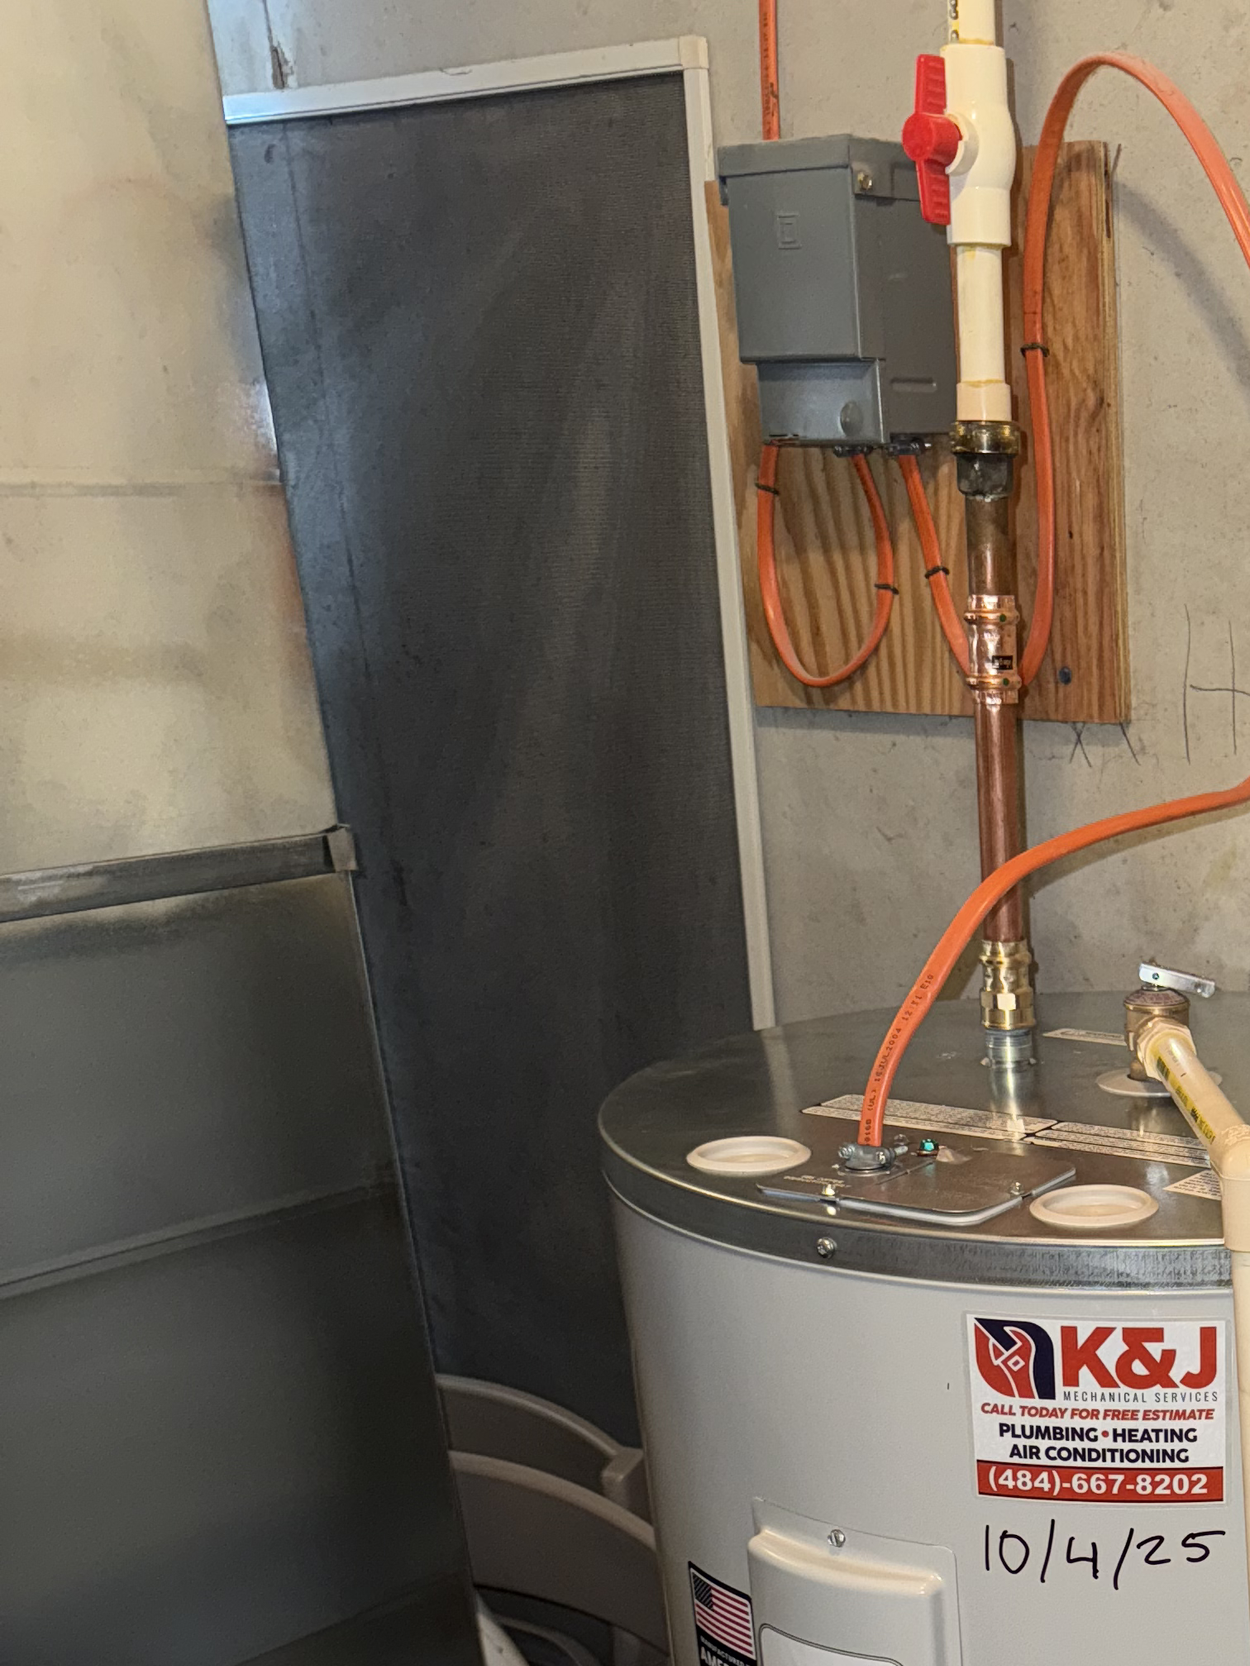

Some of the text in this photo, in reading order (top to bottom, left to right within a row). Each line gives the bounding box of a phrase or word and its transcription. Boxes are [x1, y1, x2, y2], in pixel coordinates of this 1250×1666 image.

[1060, 1325, 1218, 1389] K&J
[1063, 1391, 1218, 1403] MECHANICAL SERVICES
[981, 1402, 1215, 1421] CALL TODAY FOR FREE ESTIMATE
[999, 1423, 1198, 1443] PLUMBING HEATING
[1009, 1444, 1189, 1463] AIR CONDITIONING
[988, 1466, 1208, 1496] (484)-667-8202
[985, 1519, 1226, 1590] 10/4/25
